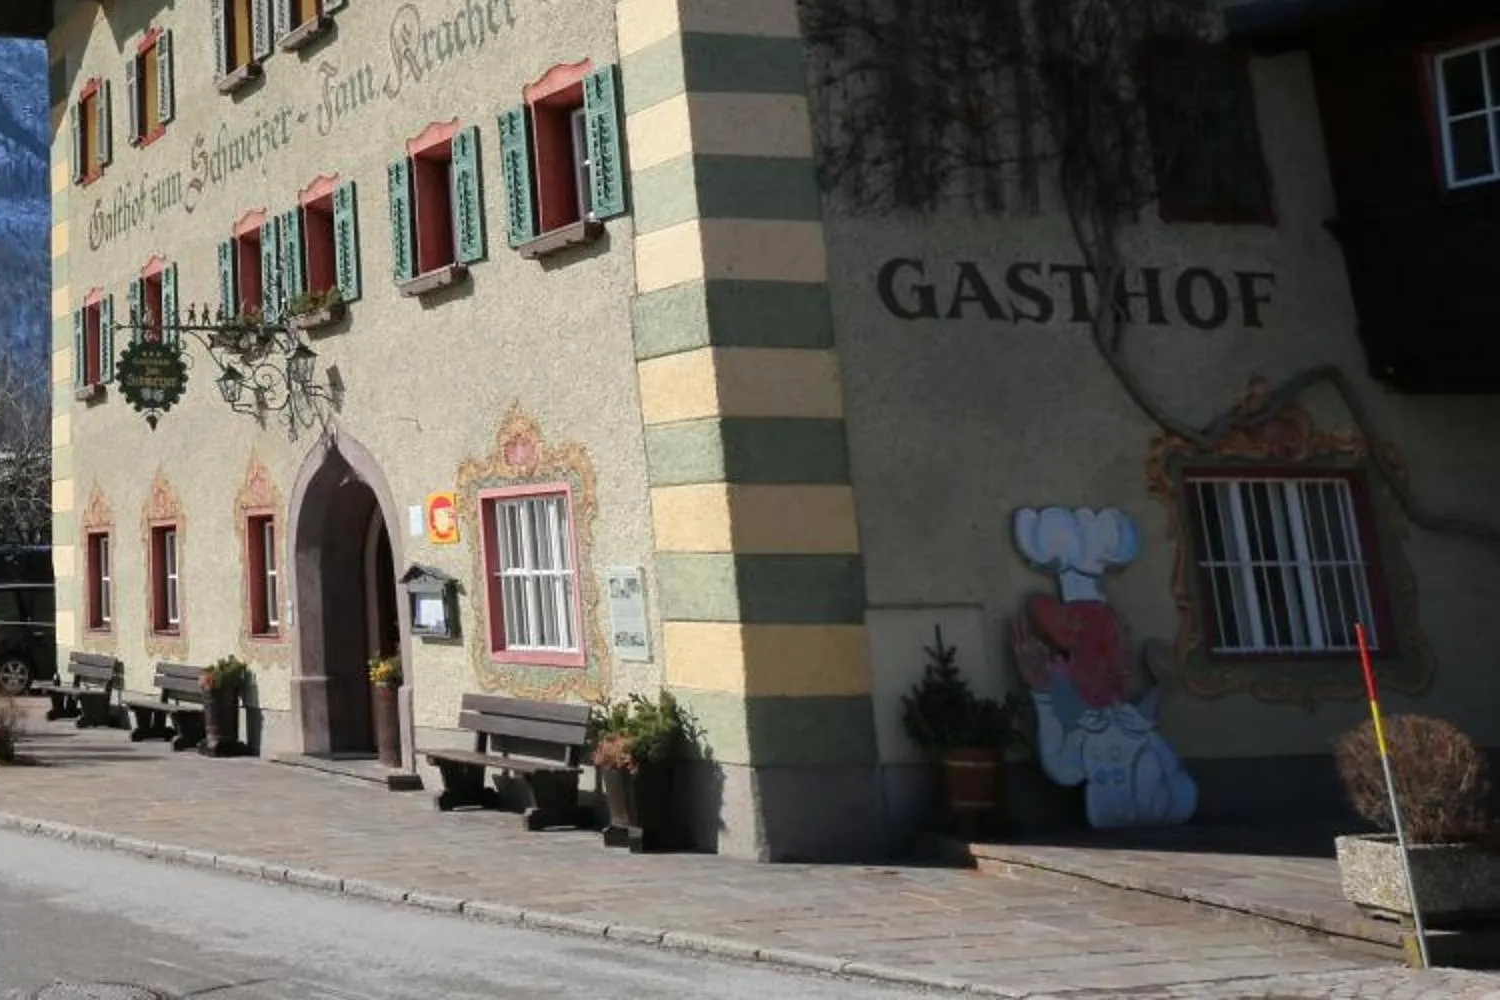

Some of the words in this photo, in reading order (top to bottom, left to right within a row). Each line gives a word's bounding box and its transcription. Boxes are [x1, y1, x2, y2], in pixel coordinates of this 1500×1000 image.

[151, 170, 182, 228] zum
[185, 105, 294, 214] Schweizer
[876, 257, 1276, 331] GASTHOF
